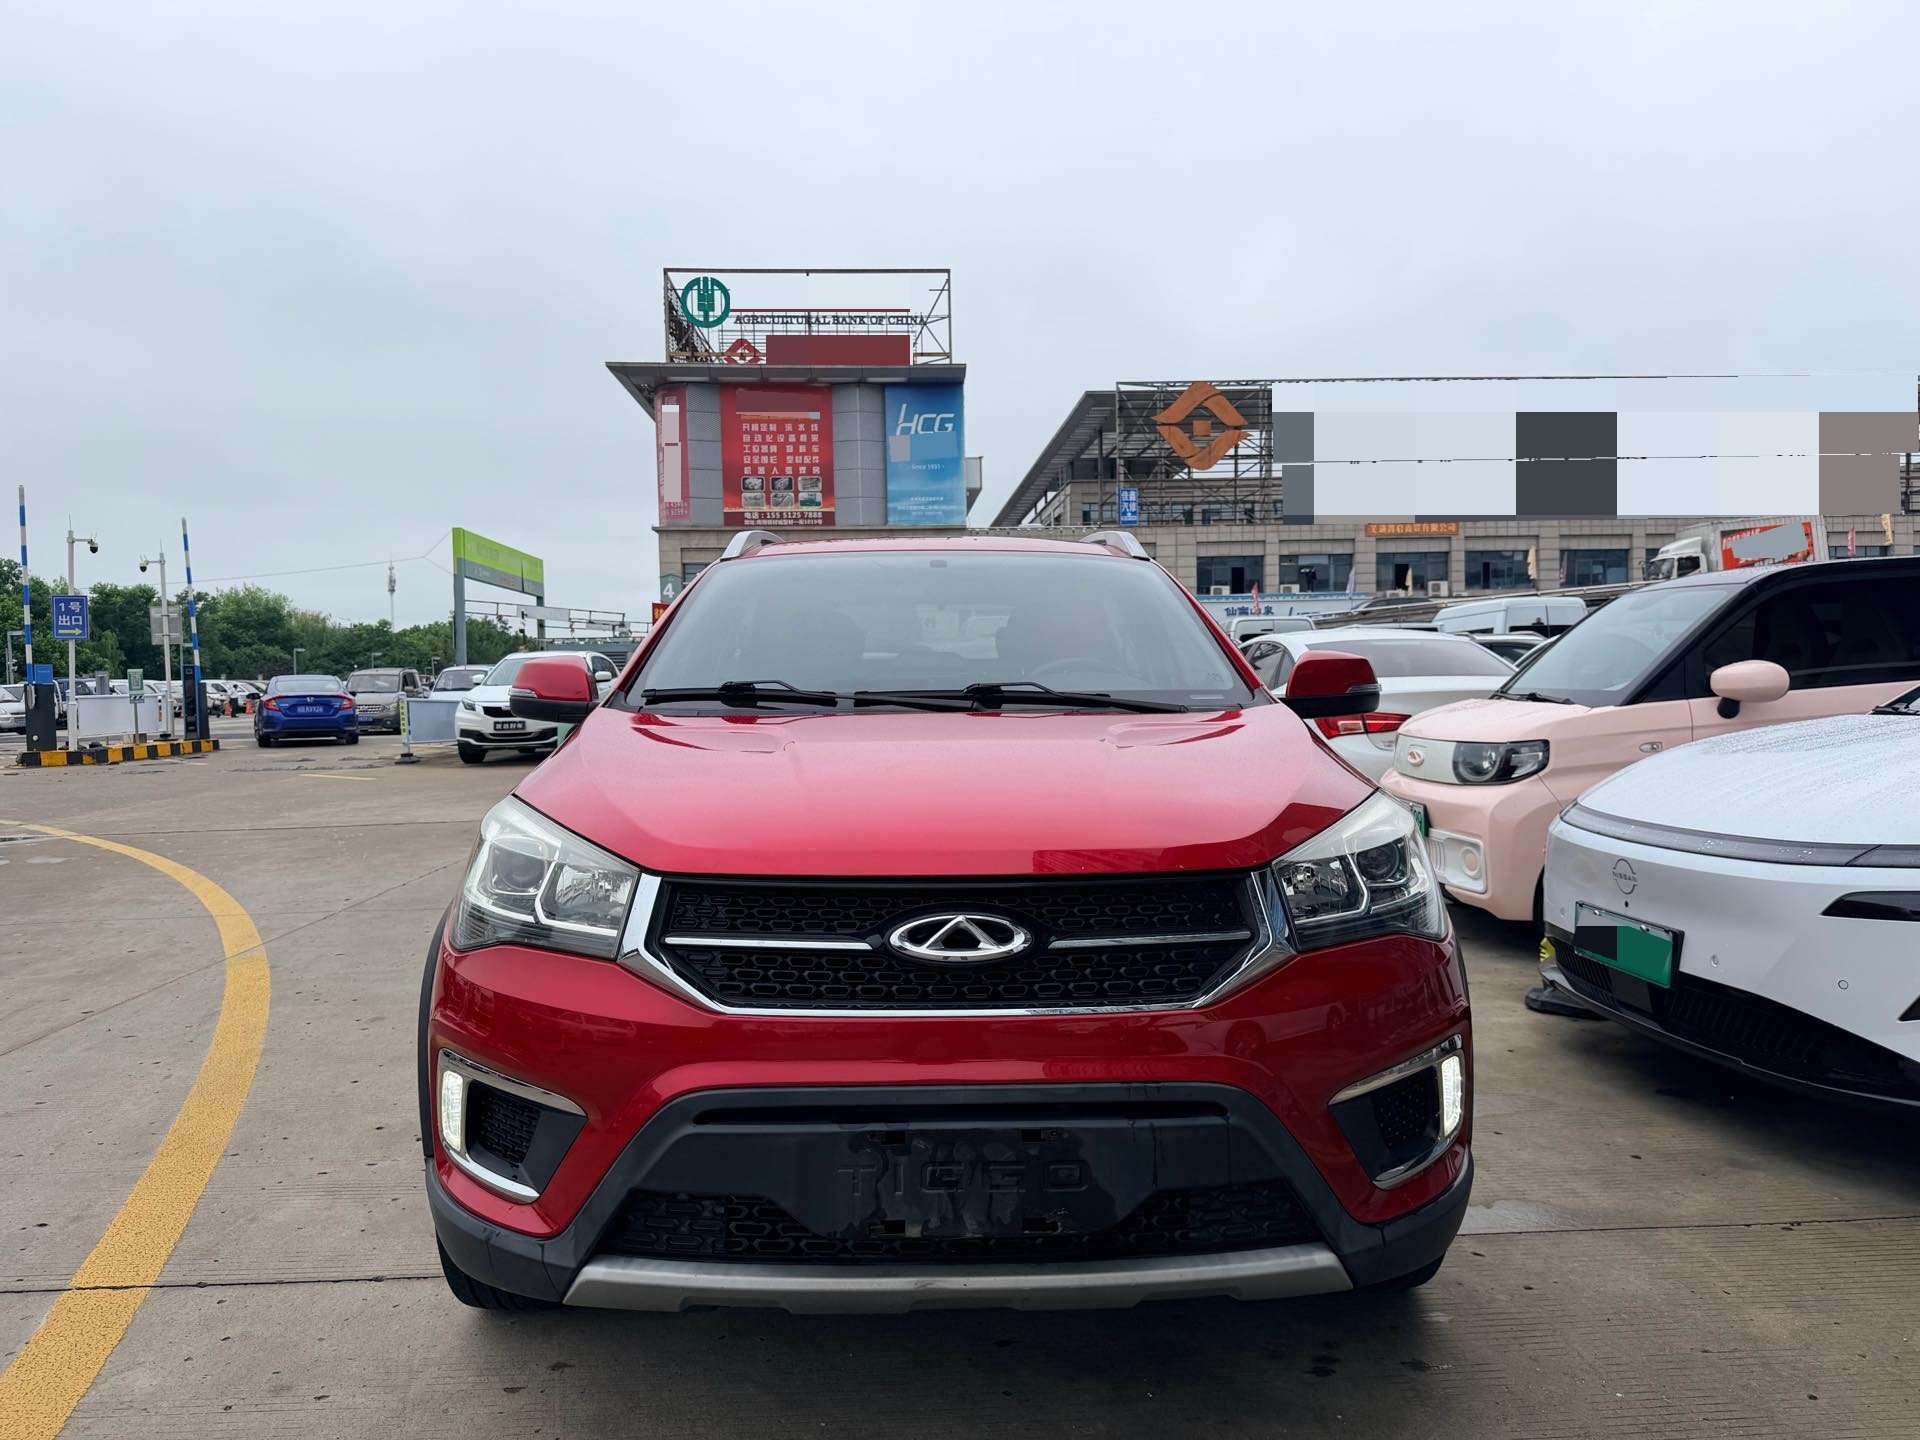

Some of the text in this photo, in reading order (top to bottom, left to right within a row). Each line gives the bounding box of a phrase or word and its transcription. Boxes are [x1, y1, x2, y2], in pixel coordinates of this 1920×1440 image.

[734, 315, 927, 325] AGRICULTURAL BANK OF CHINA
[895, 403, 956, 435] HCG
[662, 582, 675, 599] 4
[58, 601, 82, 613] 1号
[58, 614, 83, 626] 出口
[837, 1159, 1090, 1197] TIGGO
